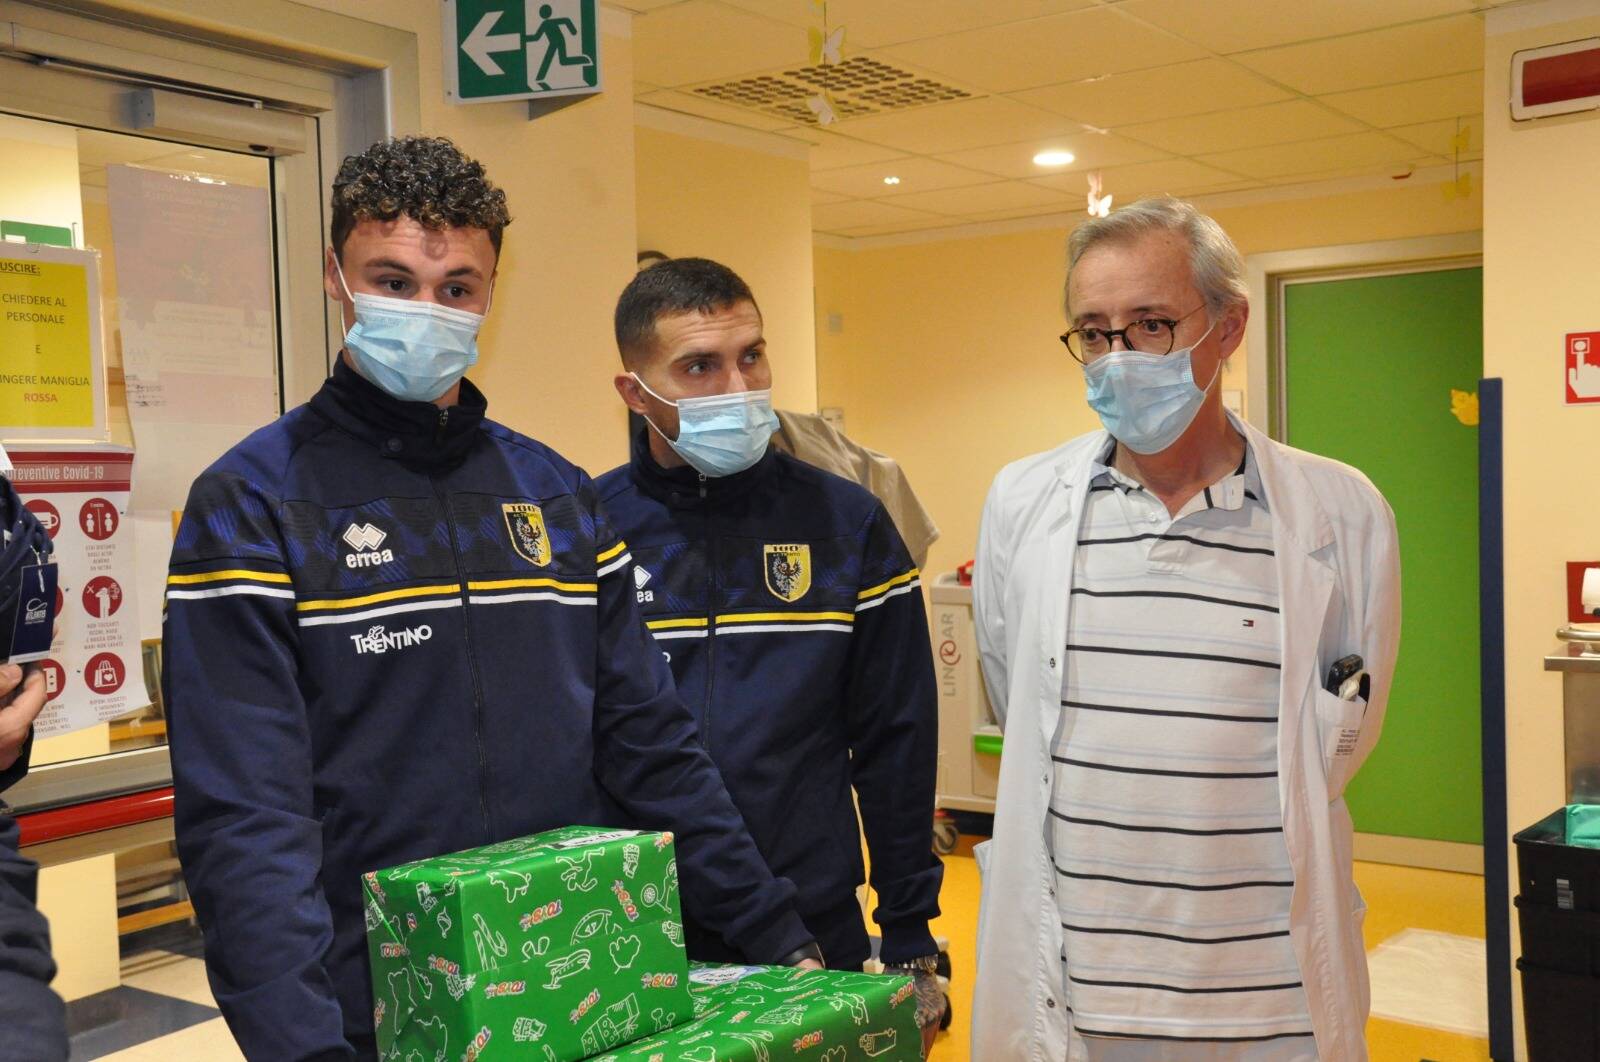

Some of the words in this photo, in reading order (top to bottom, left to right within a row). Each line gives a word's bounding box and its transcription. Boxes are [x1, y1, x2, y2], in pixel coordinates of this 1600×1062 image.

[3, 293, 51, 306] CHIEDERE
[55, 297, 66, 307] AL
[7, 312, 65, 324] PERSONALE
[35, 344, 41, 354] E
[40, 376, 90, 386] MANIGLIA
[24, 393, 57, 403] ROSSA
[63, 466, 104, 480] Covid-19
[346, 549, 394, 568] errea
[350, 625, 433, 654] TRENTINO
